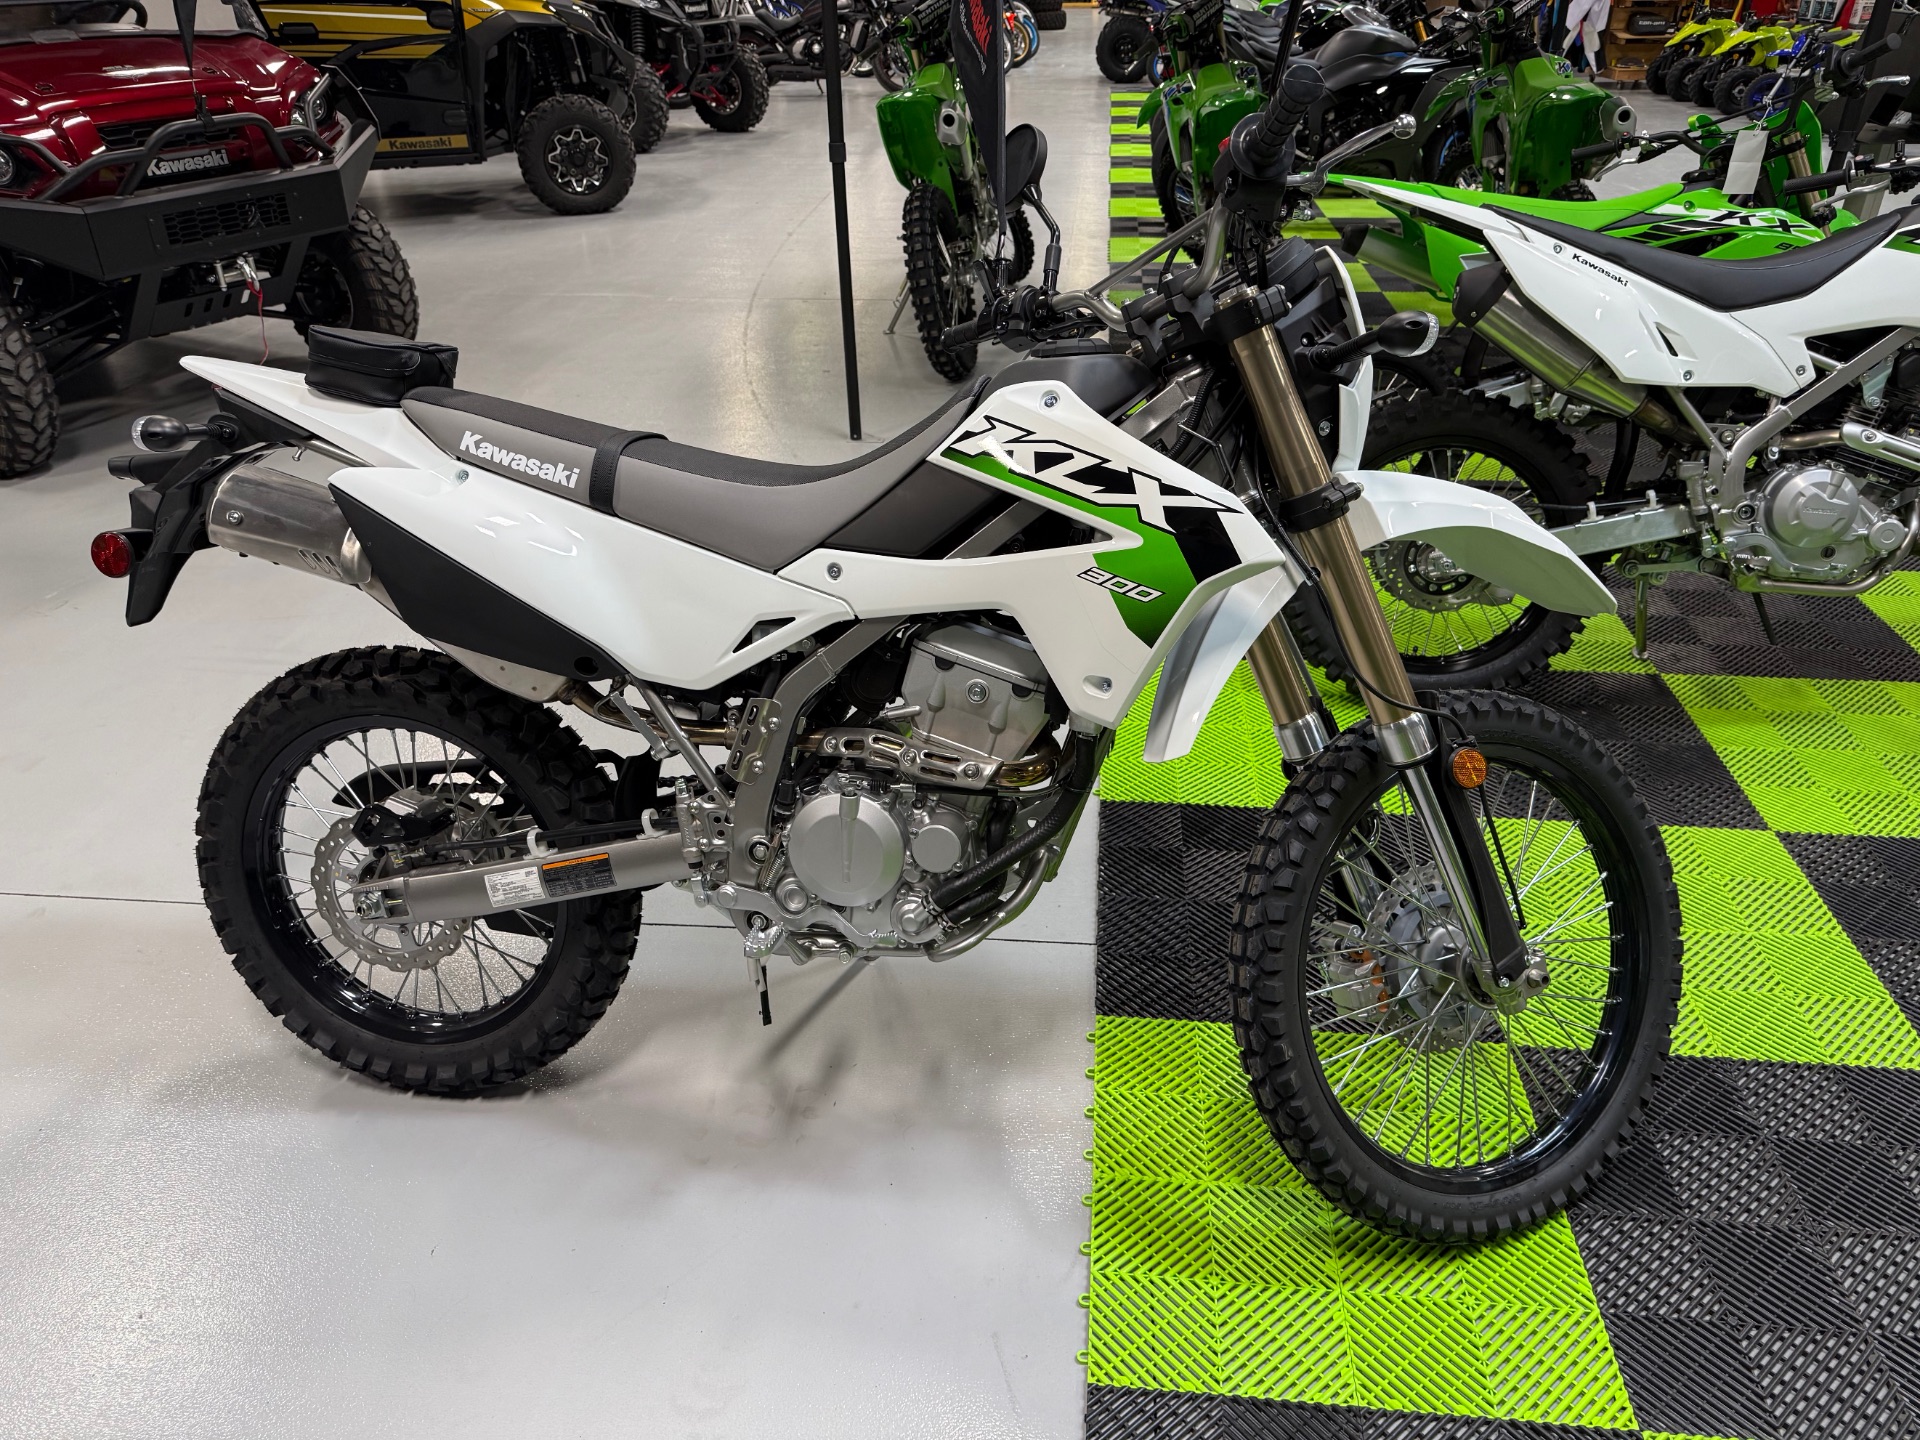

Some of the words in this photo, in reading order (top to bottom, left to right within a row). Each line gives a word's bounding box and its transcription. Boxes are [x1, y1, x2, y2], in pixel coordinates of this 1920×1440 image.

[388, 137, 452, 150] Kawasaki
[146, 149, 229, 177] Kawasaki
[1572, 253, 1629, 287] Kawasaki
[459, 430, 580, 489] Kawasaki
[948, 414, 1245, 535] KLX
[1076, 566, 1166, 603] 300
